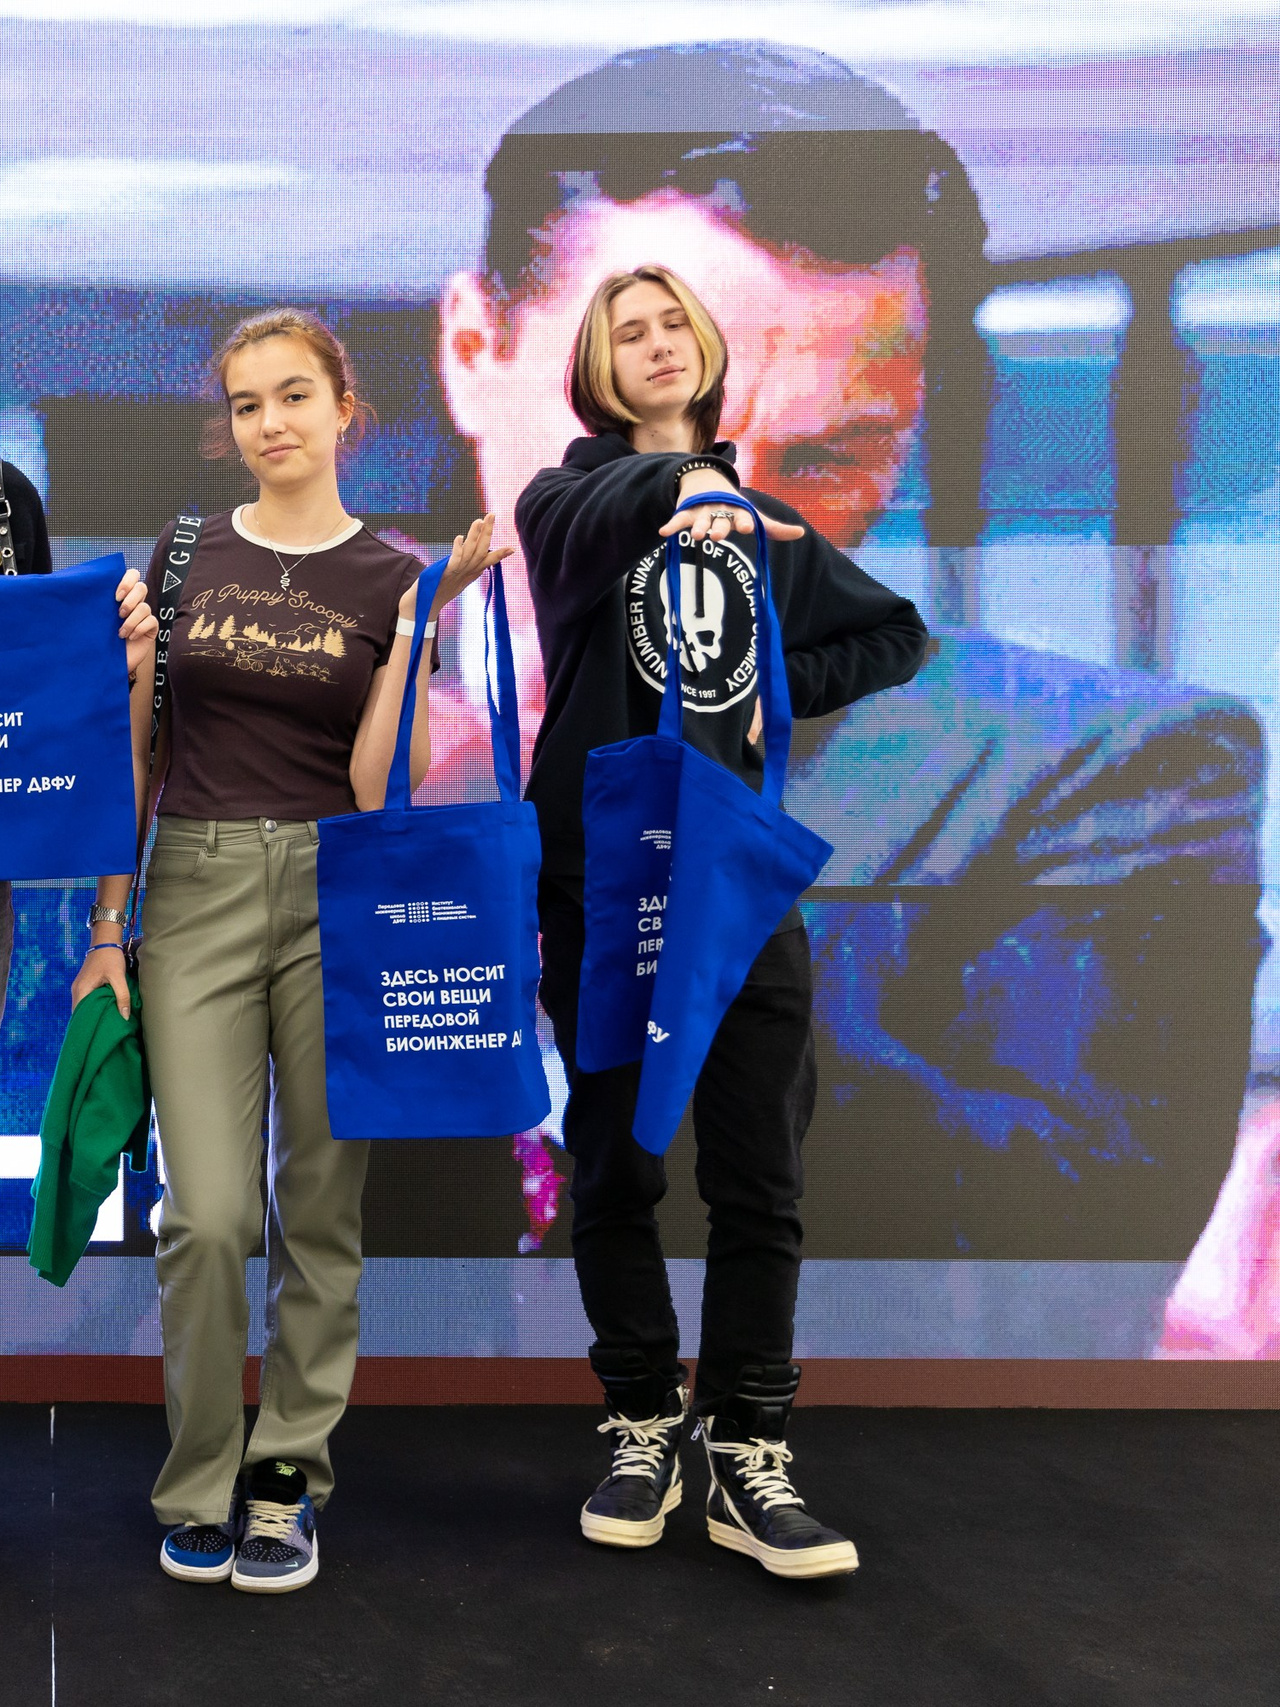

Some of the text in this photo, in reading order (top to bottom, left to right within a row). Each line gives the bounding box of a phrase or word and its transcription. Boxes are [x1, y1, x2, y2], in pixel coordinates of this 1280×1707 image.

[702, 539, 724, 558] OF
[630, 556, 655, 595] NINE
[190, 583, 358, 628] A Puppy Snoopy
[630, 601, 668, 679] NUMBER
[154, 607, 175, 709] GUESS
[681, 683, 716, 698] NCE 1997
[27, 775, 76, 794] ДВФУ
[380, 964, 506, 988] ЗДЕСЬ НОСИТ
[383, 988, 492, 1008] СВОИ ВЕЩИ
[384, 1008, 480, 1029] ПЕРЕДОВОЙ
[386, 1032, 508, 1052] БИОИНЖЕНЕР
